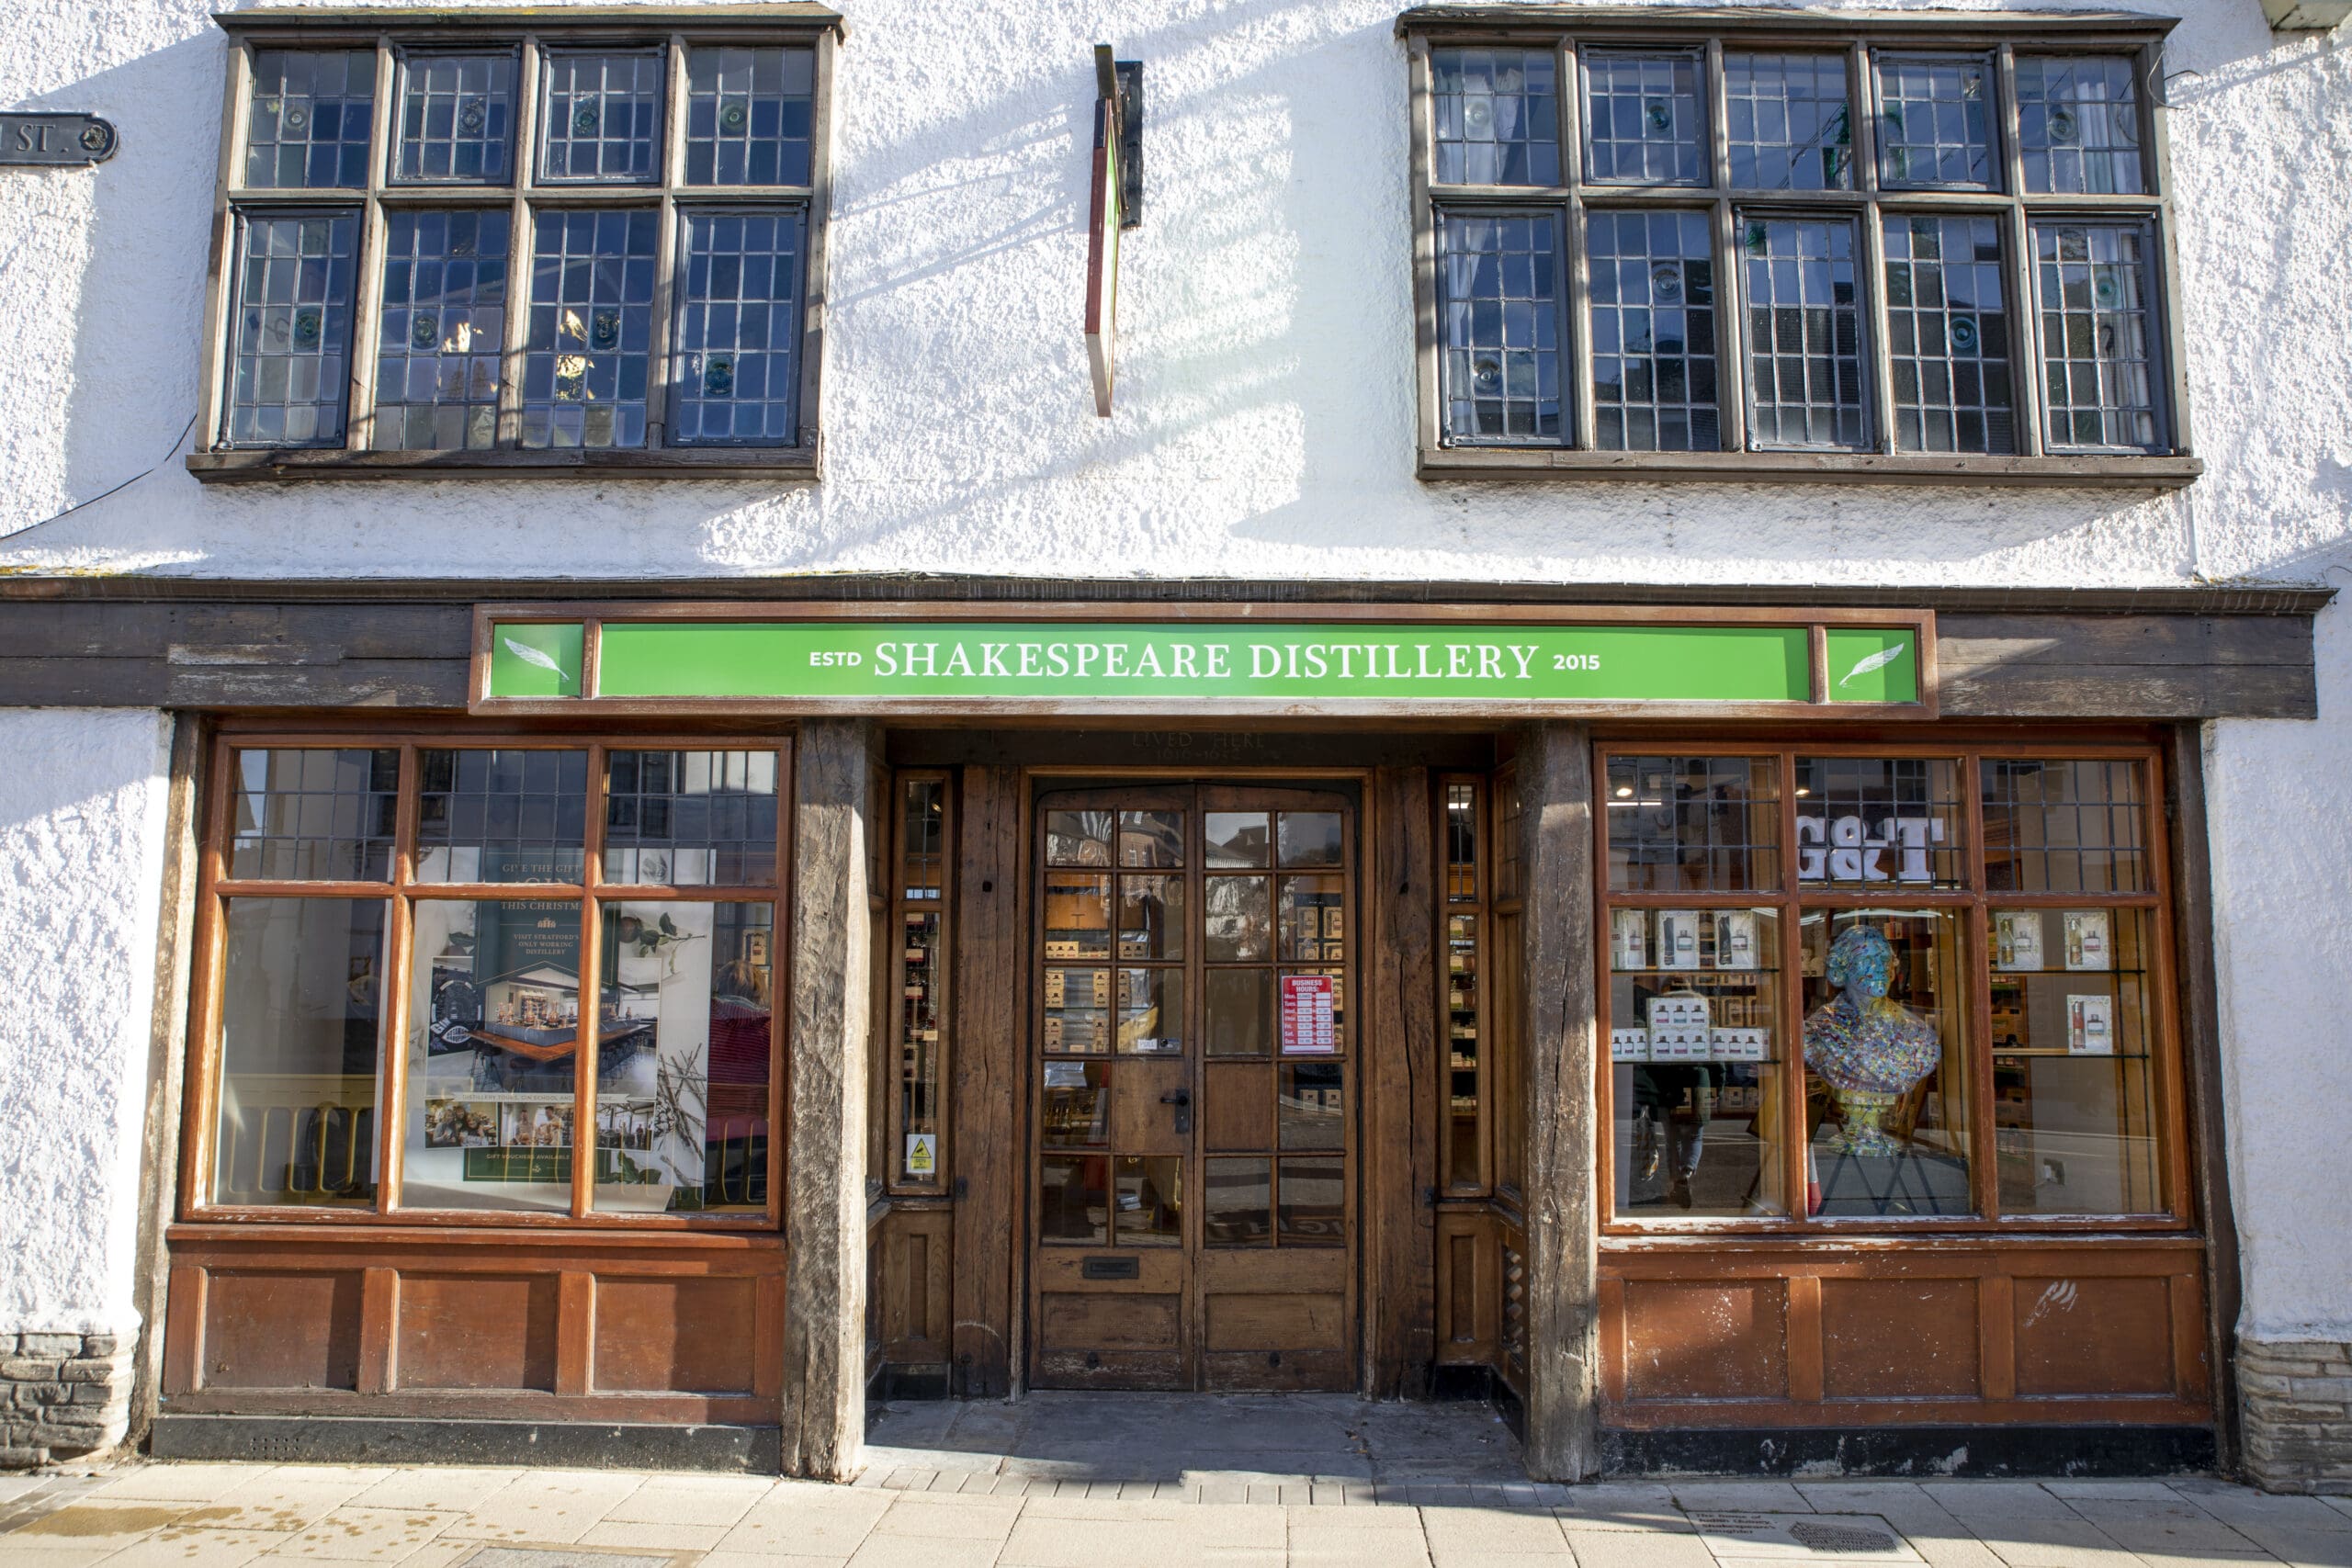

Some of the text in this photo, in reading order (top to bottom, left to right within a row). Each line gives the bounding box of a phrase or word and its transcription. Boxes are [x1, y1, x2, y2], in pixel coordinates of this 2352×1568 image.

[809, 642, 1600, 679] ESTD SHAKESPEARE DISTILLERY 2015
[1796, 815, 1944, 880] G&T
[531, 863, 552, 873] THE
[555, 864, 581, 873] GIFT
[501, 901, 582, 910] THIS CHRISTM
